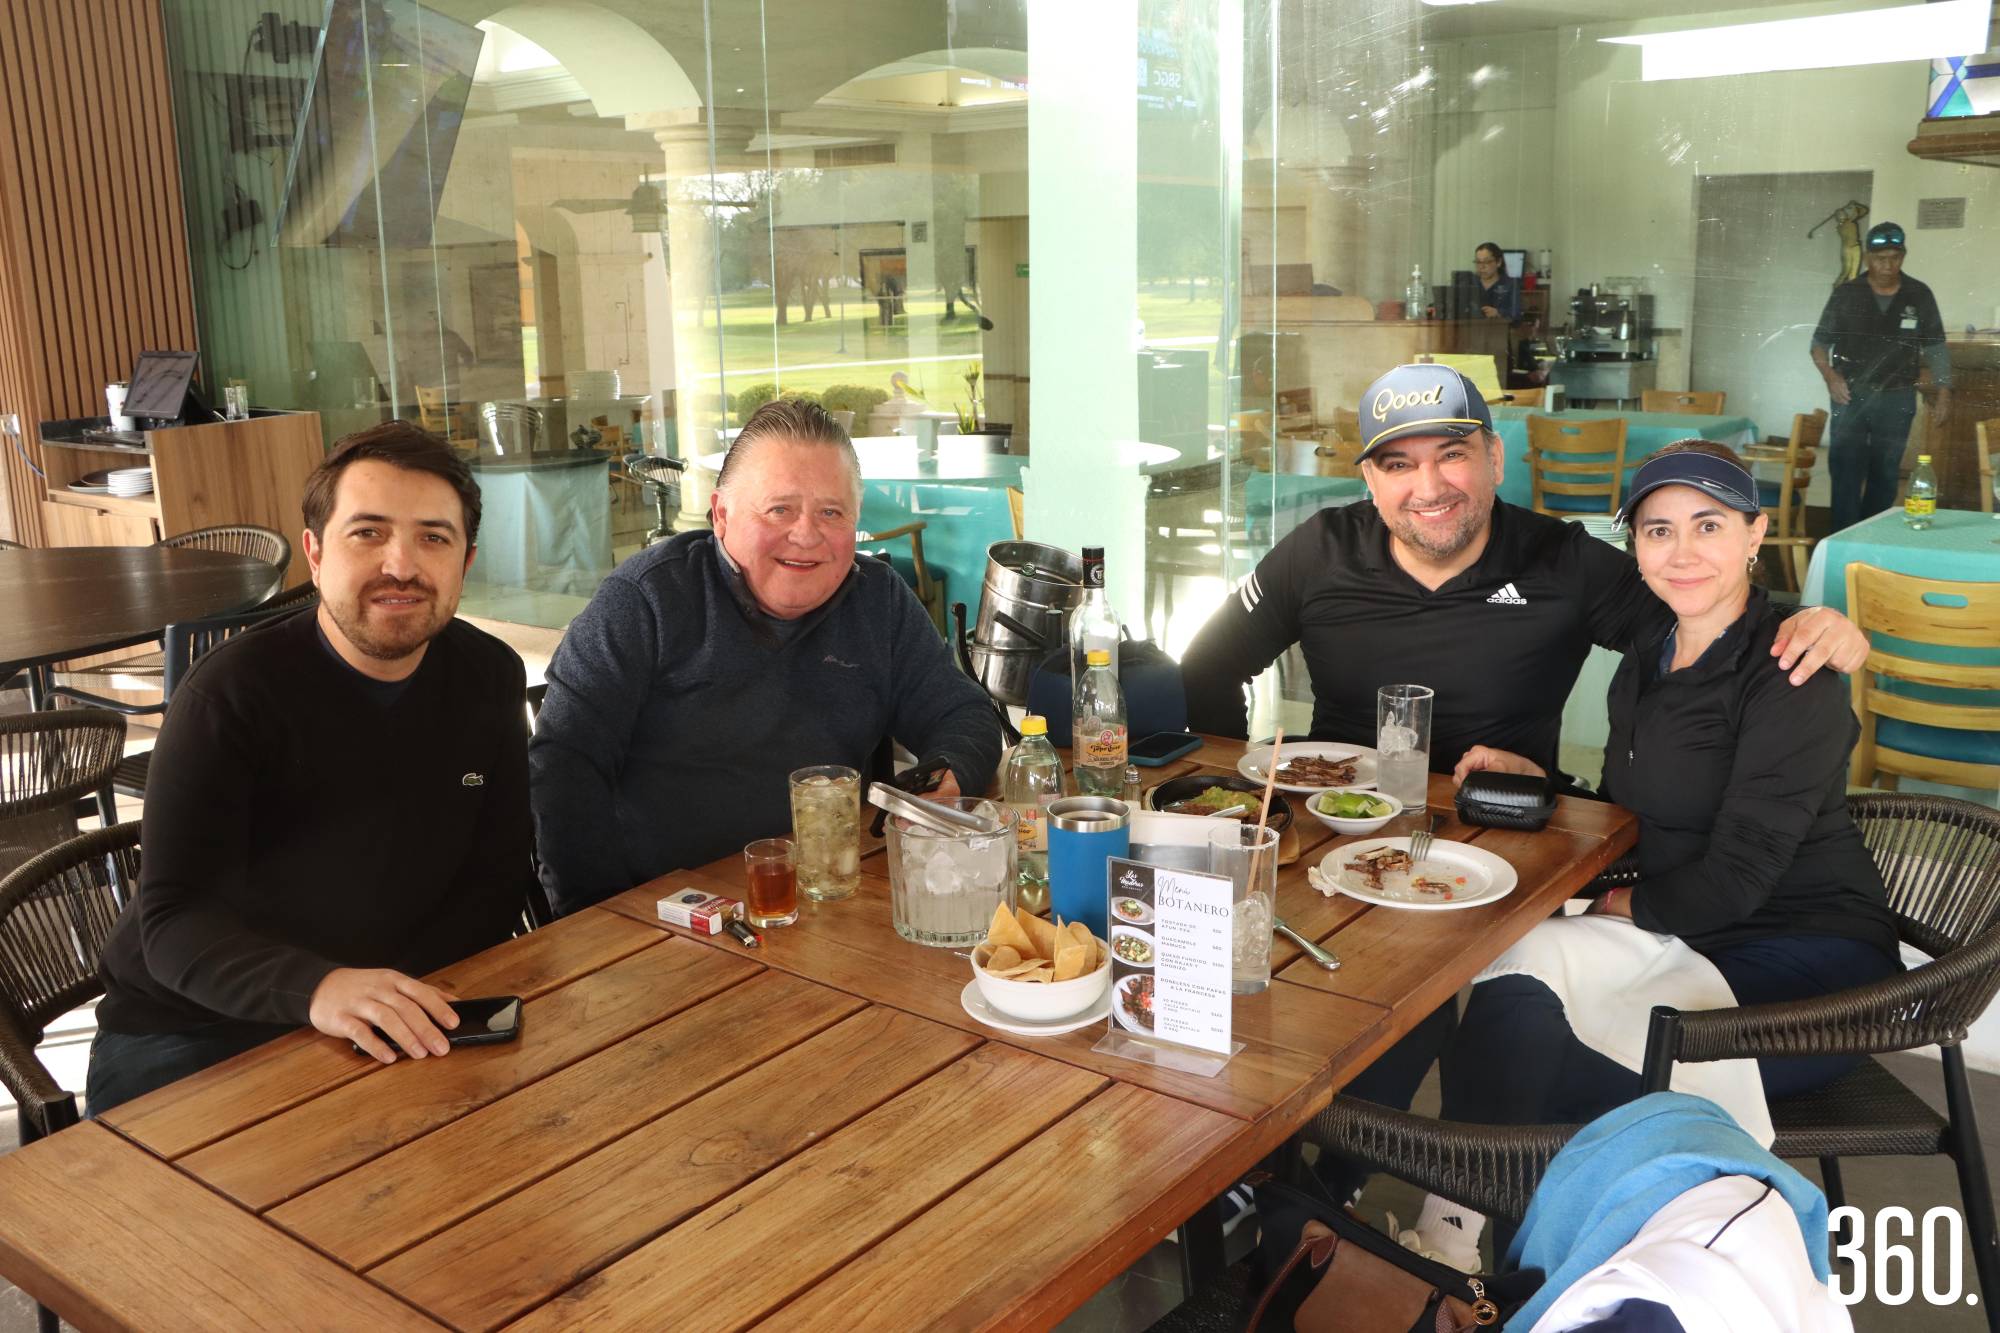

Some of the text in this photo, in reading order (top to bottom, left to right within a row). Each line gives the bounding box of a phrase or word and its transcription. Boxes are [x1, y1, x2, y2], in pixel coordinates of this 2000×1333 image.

[1372, 384, 1443, 422] Good
[1486, 596, 1527, 605] adidas
[1158, 896, 1229, 917] BOTANERO
